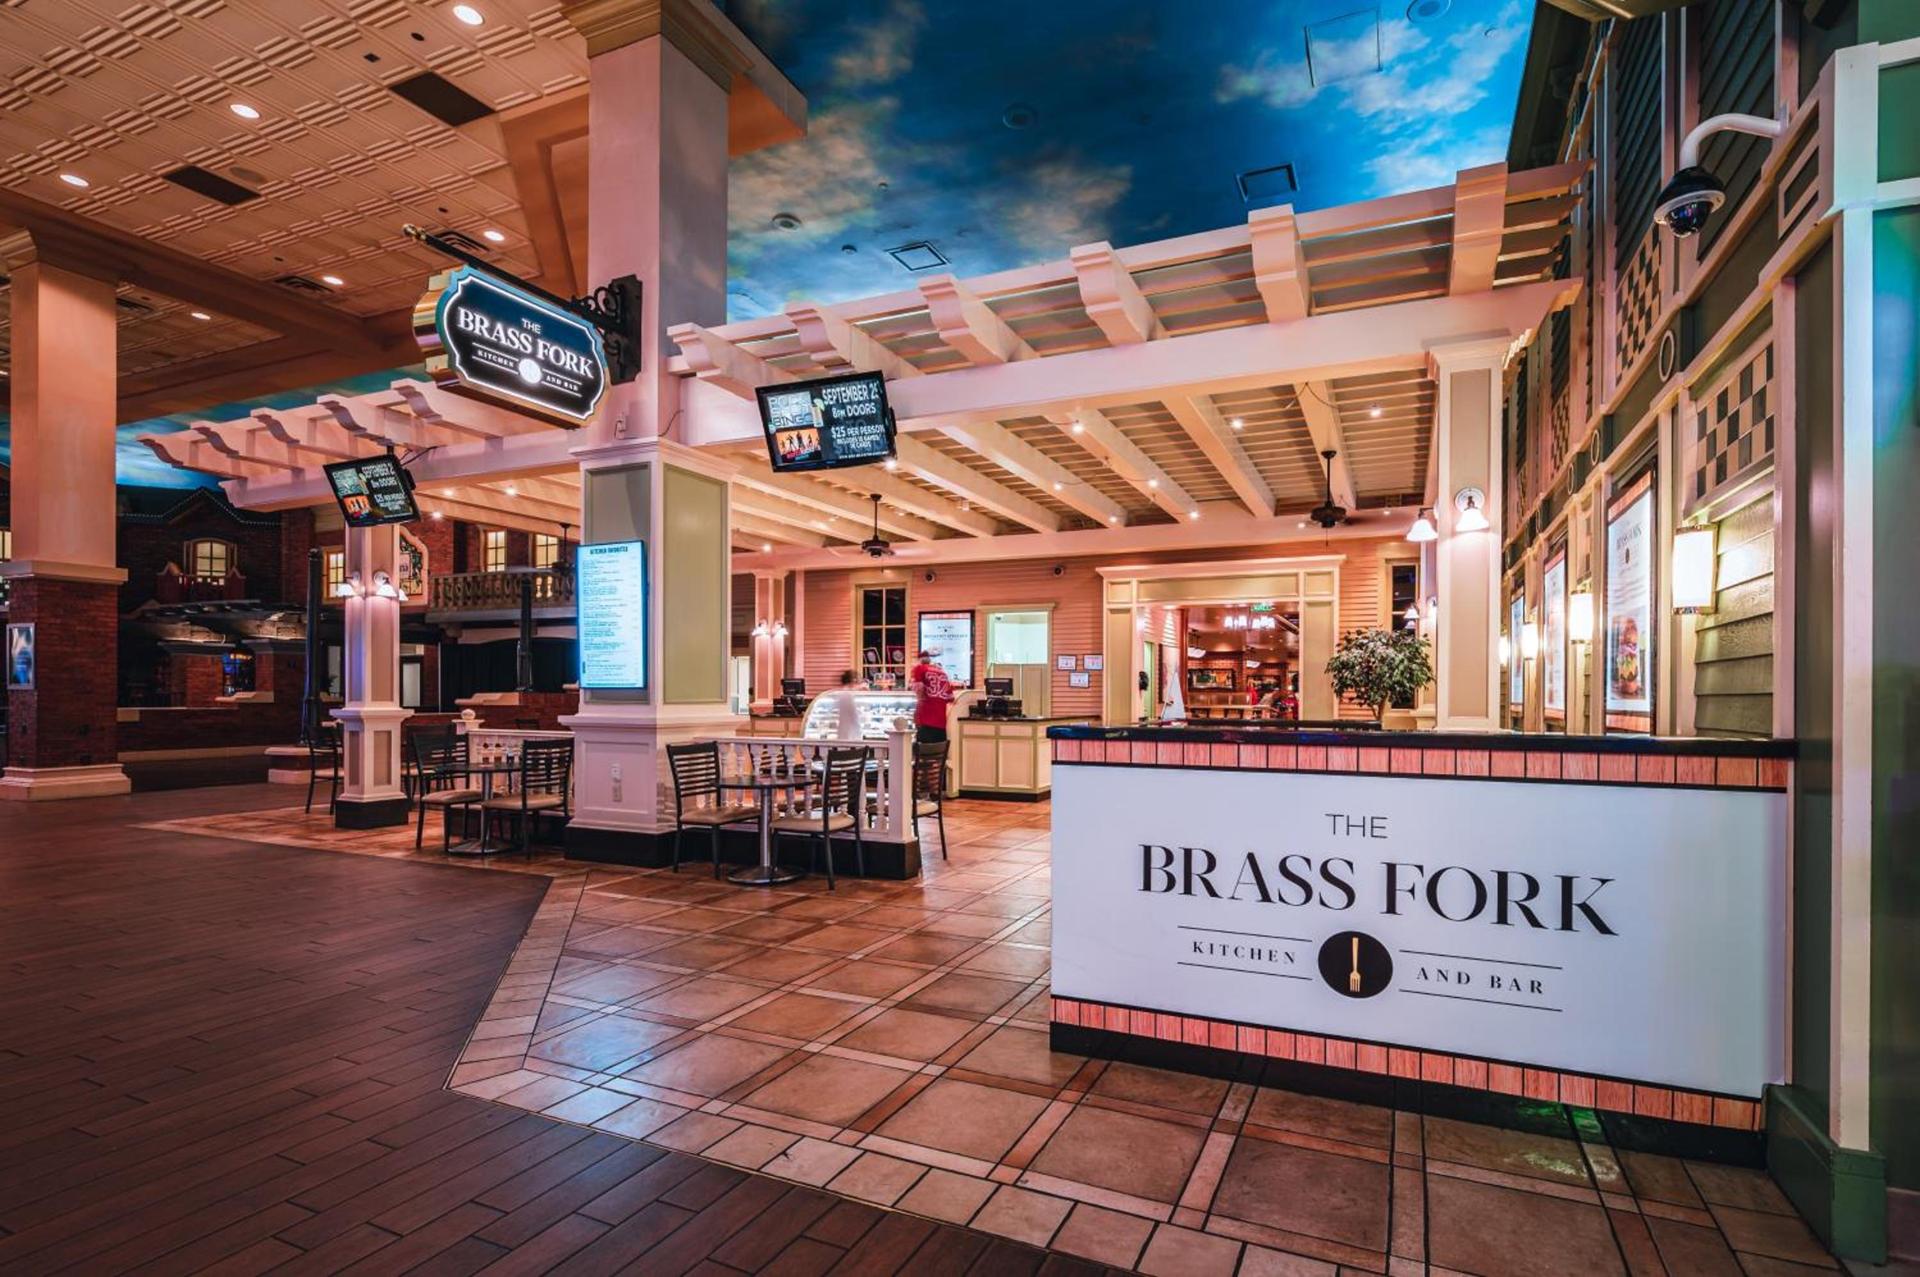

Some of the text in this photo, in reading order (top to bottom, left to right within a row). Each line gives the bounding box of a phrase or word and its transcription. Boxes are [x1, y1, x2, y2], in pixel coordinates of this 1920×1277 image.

[521, 318, 541, 334] THE
[457, 306, 594, 379] BRASS FORK
[477, 349, 514, 367] KITCHEN
[546, 375, 579, 392] AND BAR
[822, 384, 869, 405] SEPTEMBER
[846, 402, 877, 417] DOORS
[831, 426, 846, 439] $25
[860, 424, 886, 436] PERSON
[925, 671, 950, 699] 32
[1325, 813, 1388, 839] THE
[1138, 844, 1620, 937] BRASS FORK
[1192, 941, 1297, 965] KITCHEN
[1416, 967, 1545, 995] AND BAR
